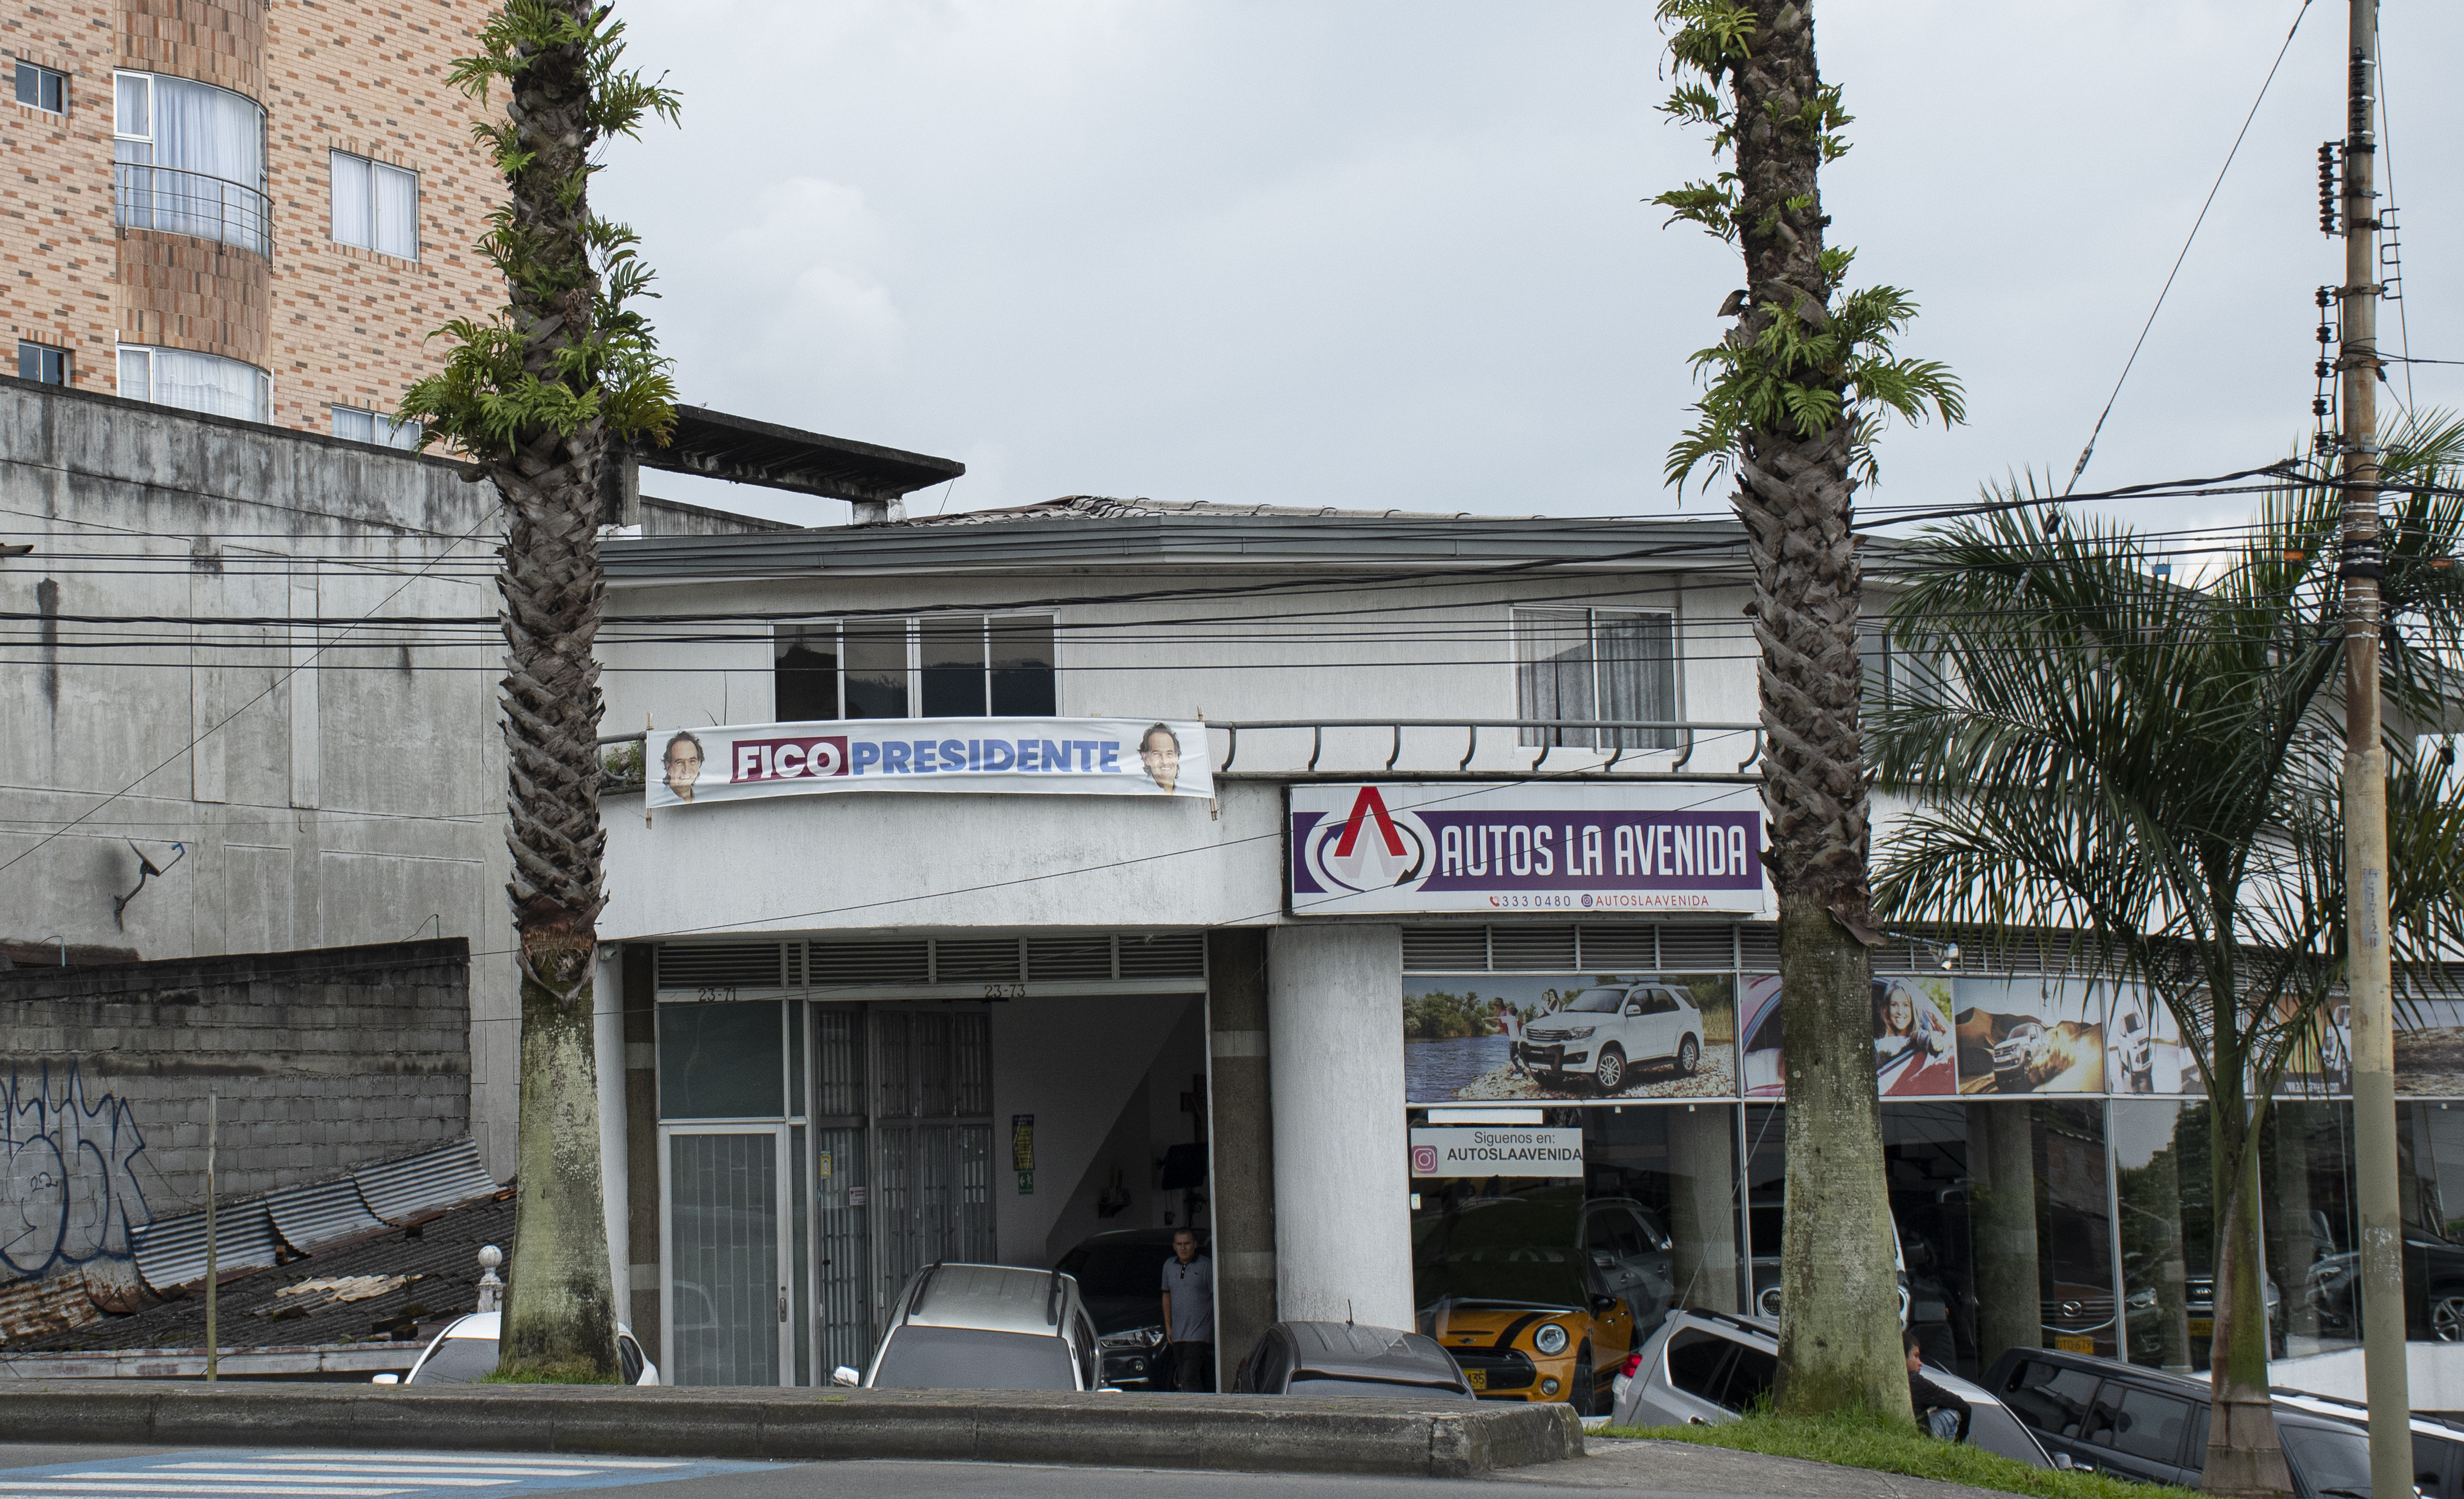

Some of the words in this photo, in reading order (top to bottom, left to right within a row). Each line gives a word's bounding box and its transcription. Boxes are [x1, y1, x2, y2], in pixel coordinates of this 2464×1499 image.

[738, 742, 840, 779] FICO
[851, 739, 1122, 775] PRESIDENTE
[1441, 825, 1554, 876] AUTOS
[1566, 825, 1603, 876] LA
[1614, 825, 1747, 876] AVENIDA
[1502, 895, 1529, 907] 333
[1534, 895, 1571, 907] 0480
[1596, 894, 1709, 907] AUTOSLAAVENIDA
[698, 987, 736, 1001] 23-71
[984, 984, 1026, 998] 23-73
[1473, 1131, 1533, 1146] Siguenos
[1536, 1133, 1556, 1144] en:
[1446, 1147, 1583, 1161] AUTOSLAAVENIDA
